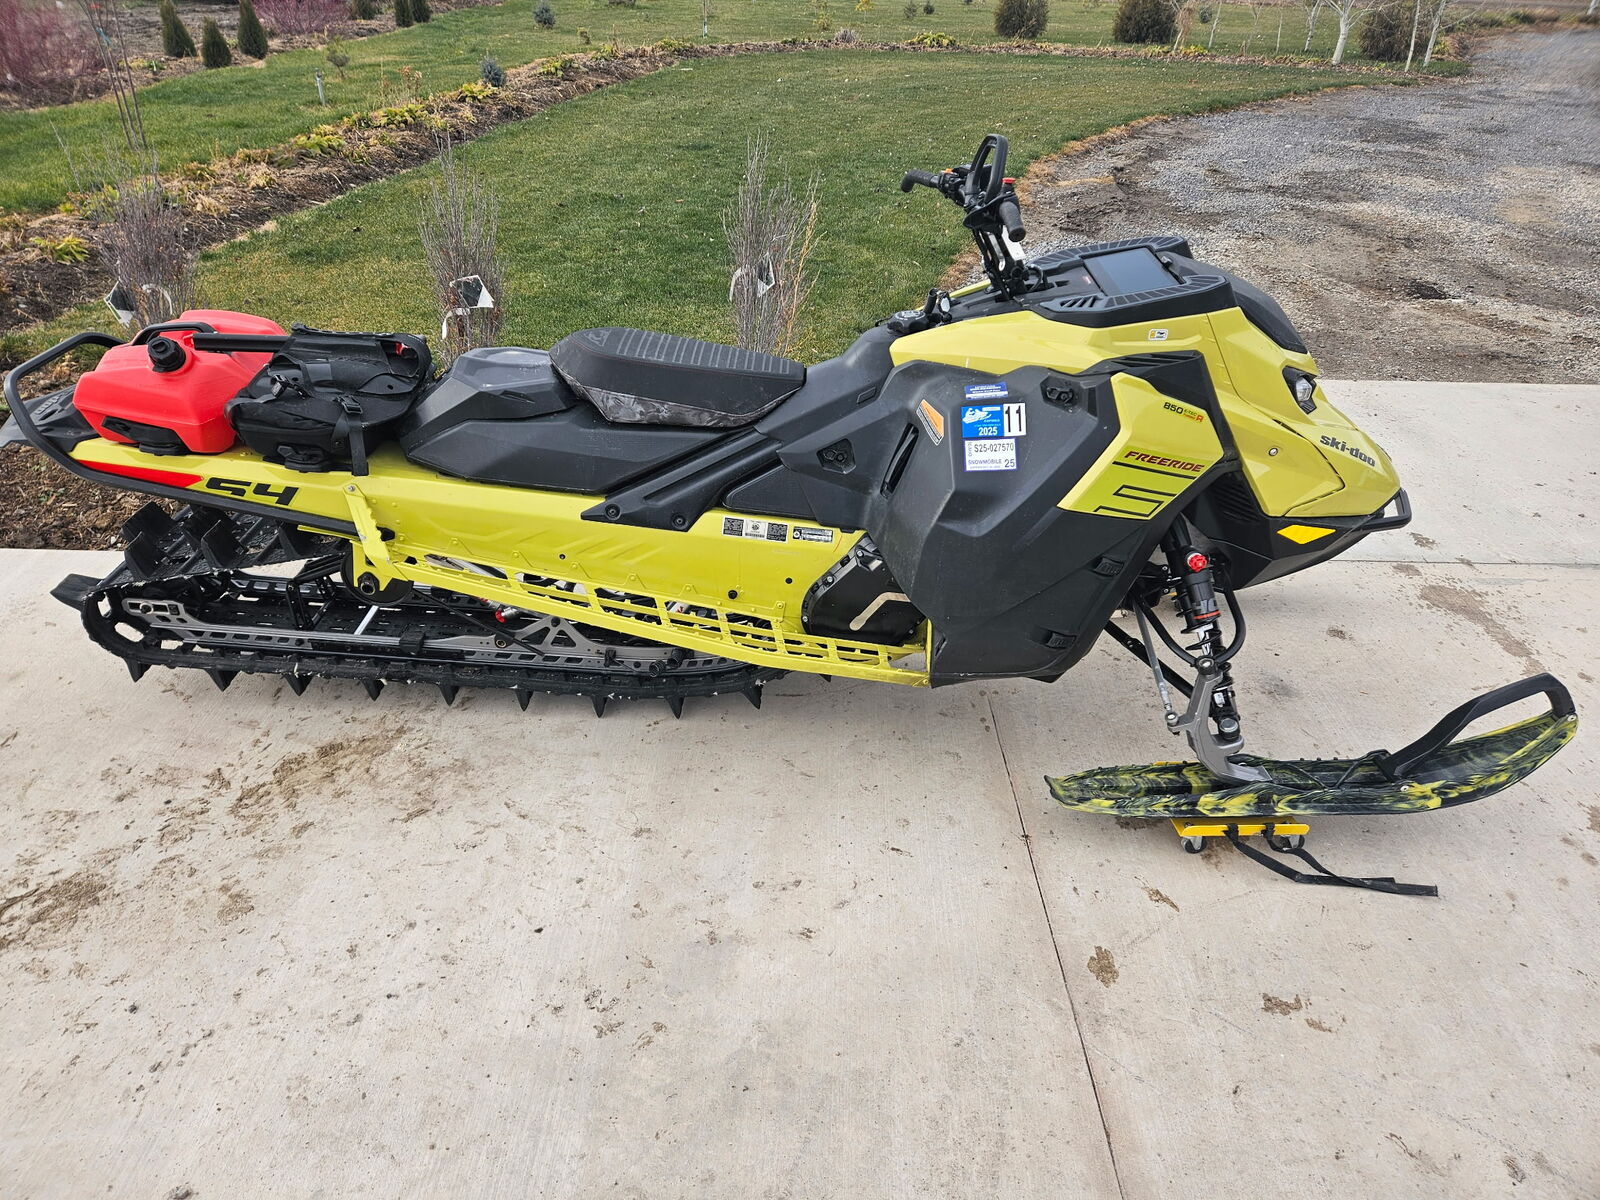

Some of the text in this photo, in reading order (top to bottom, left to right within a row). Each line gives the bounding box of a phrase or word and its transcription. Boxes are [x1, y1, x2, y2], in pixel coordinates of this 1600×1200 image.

[1163, 401, 1184, 415] 850
[1005, 405, 1022, 433] 11
[1196, 414, 1205, 423] R
[978, 426, 998, 436] 2025
[974, 442, 1015, 453] S25-027570
[967, 458, 1003, 466] SNOWMOBILE
[1004, 458, 1016, 468] 25
[1124, 450, 1205, 473] FREERIDE
